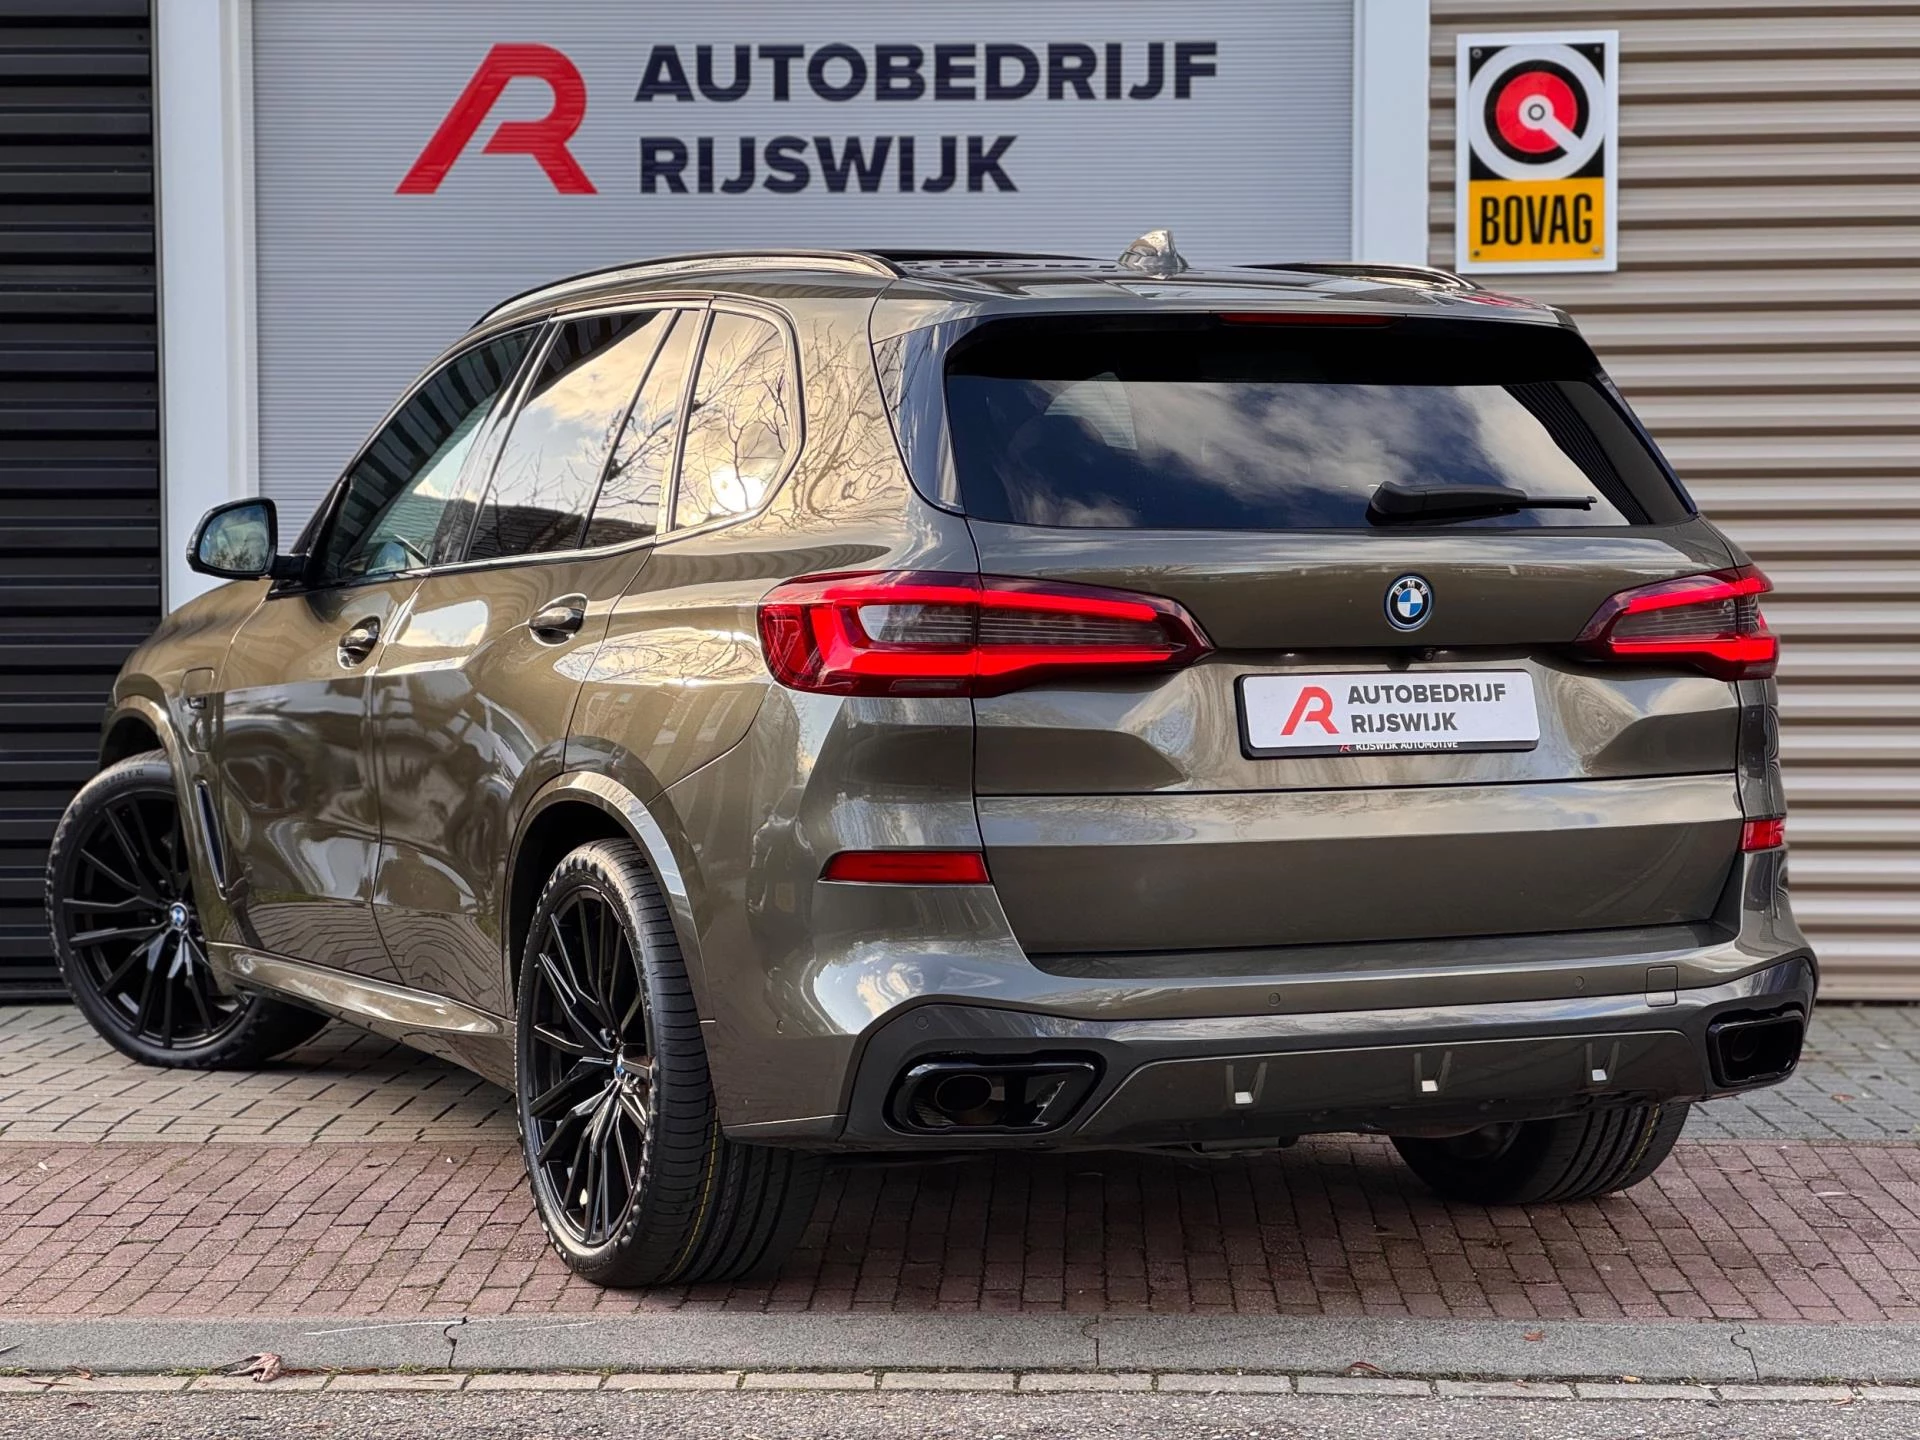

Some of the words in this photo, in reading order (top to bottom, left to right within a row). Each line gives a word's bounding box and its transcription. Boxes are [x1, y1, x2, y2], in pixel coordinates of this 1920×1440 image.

[634, 42, 1217, 102] AUTOBEDRIJF
[640, 135, 1019, 195] RIJSWIJK
[1480, 193, 1593, 246] BOVAG
[1347, 683, 1507, 705] AUTOBEDRIJF
[1350, 712, 1458, 734] RIJSWIJK
[1400, 741, 1459, 750] AUTOMOTIVE
